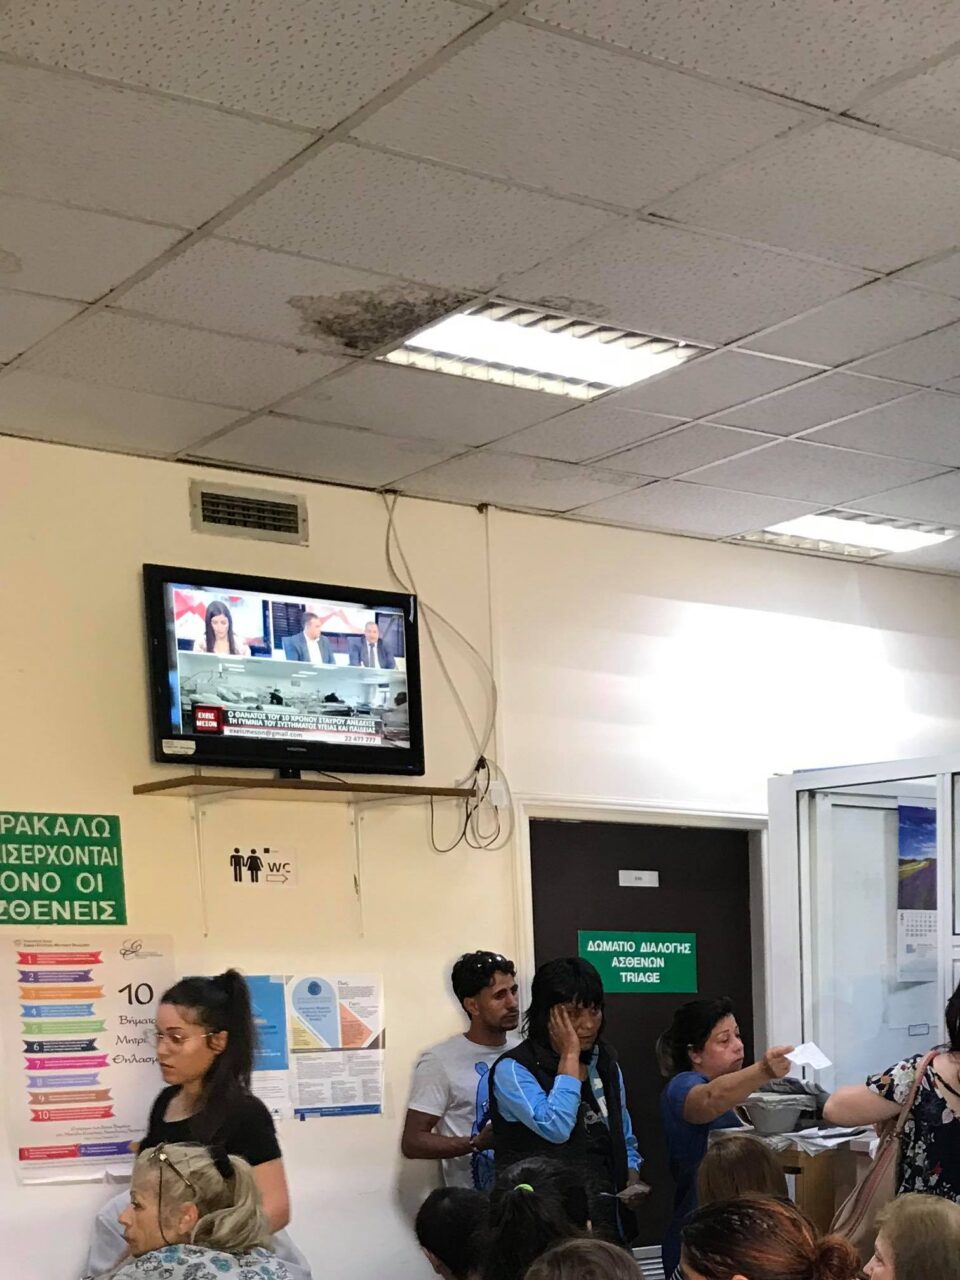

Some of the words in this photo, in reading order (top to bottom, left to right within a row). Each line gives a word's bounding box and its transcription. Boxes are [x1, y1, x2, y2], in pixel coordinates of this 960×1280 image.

[235, 711, 266, 720] ΘΑΝΑΤΟΣ
[0, 815, 111, 837] ΡΑΚΑΛΩ
[0, 844, 118, 866] ΙΣΕΡΧΟΝΤΑΙ
[267, 862, 291, 873] WC
[0, 871, 61, 893] ΟΝΟ
[76, 872, 103, 893] ΟΙ
[587, 940, 636, 952] ΔΩΜΑΤΙΟ
[640, 942, 692, 954] ΔΙΑΛΟΓΗΣ
[612, 957, 665, 968] ΑΣΘΕΝΩΝ
[620, 972, 661, 983] TRIAGE
[118, 982, 154, 1005] 10
[38, 1111, 49, 1120] 10
